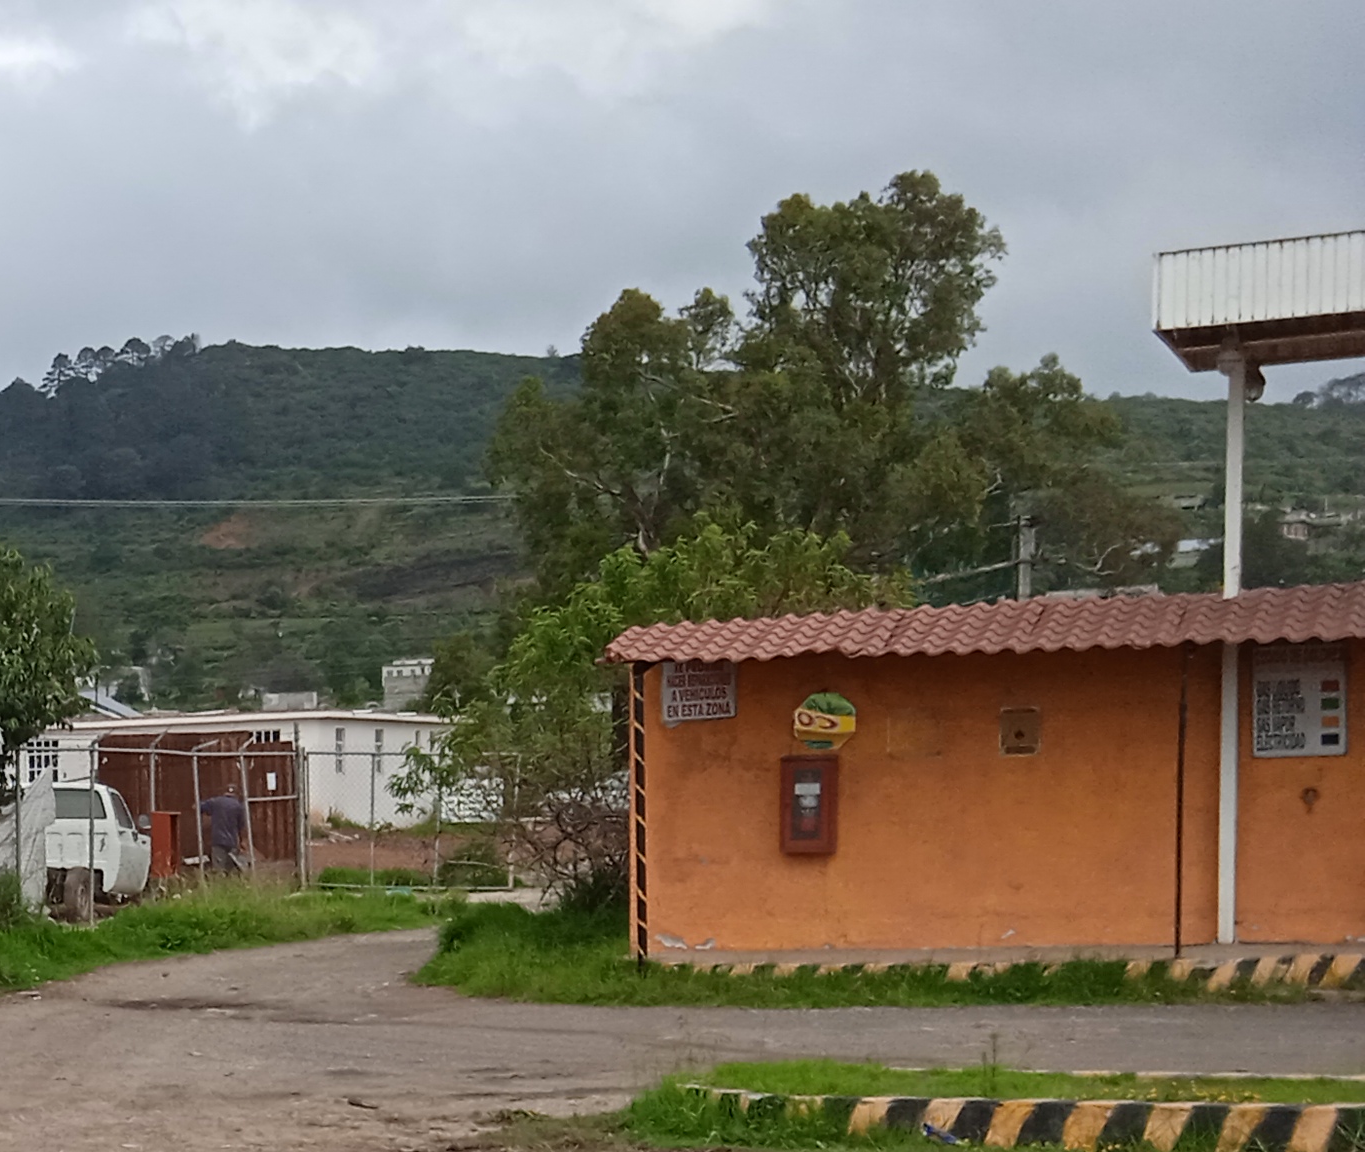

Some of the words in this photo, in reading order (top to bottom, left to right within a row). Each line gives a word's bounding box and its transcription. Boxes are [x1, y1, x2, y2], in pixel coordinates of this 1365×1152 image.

[667, 705, 679, 718] EN
[681, 703, 704, 717] ESTA
[706, 701, 731, 716] ZONA
